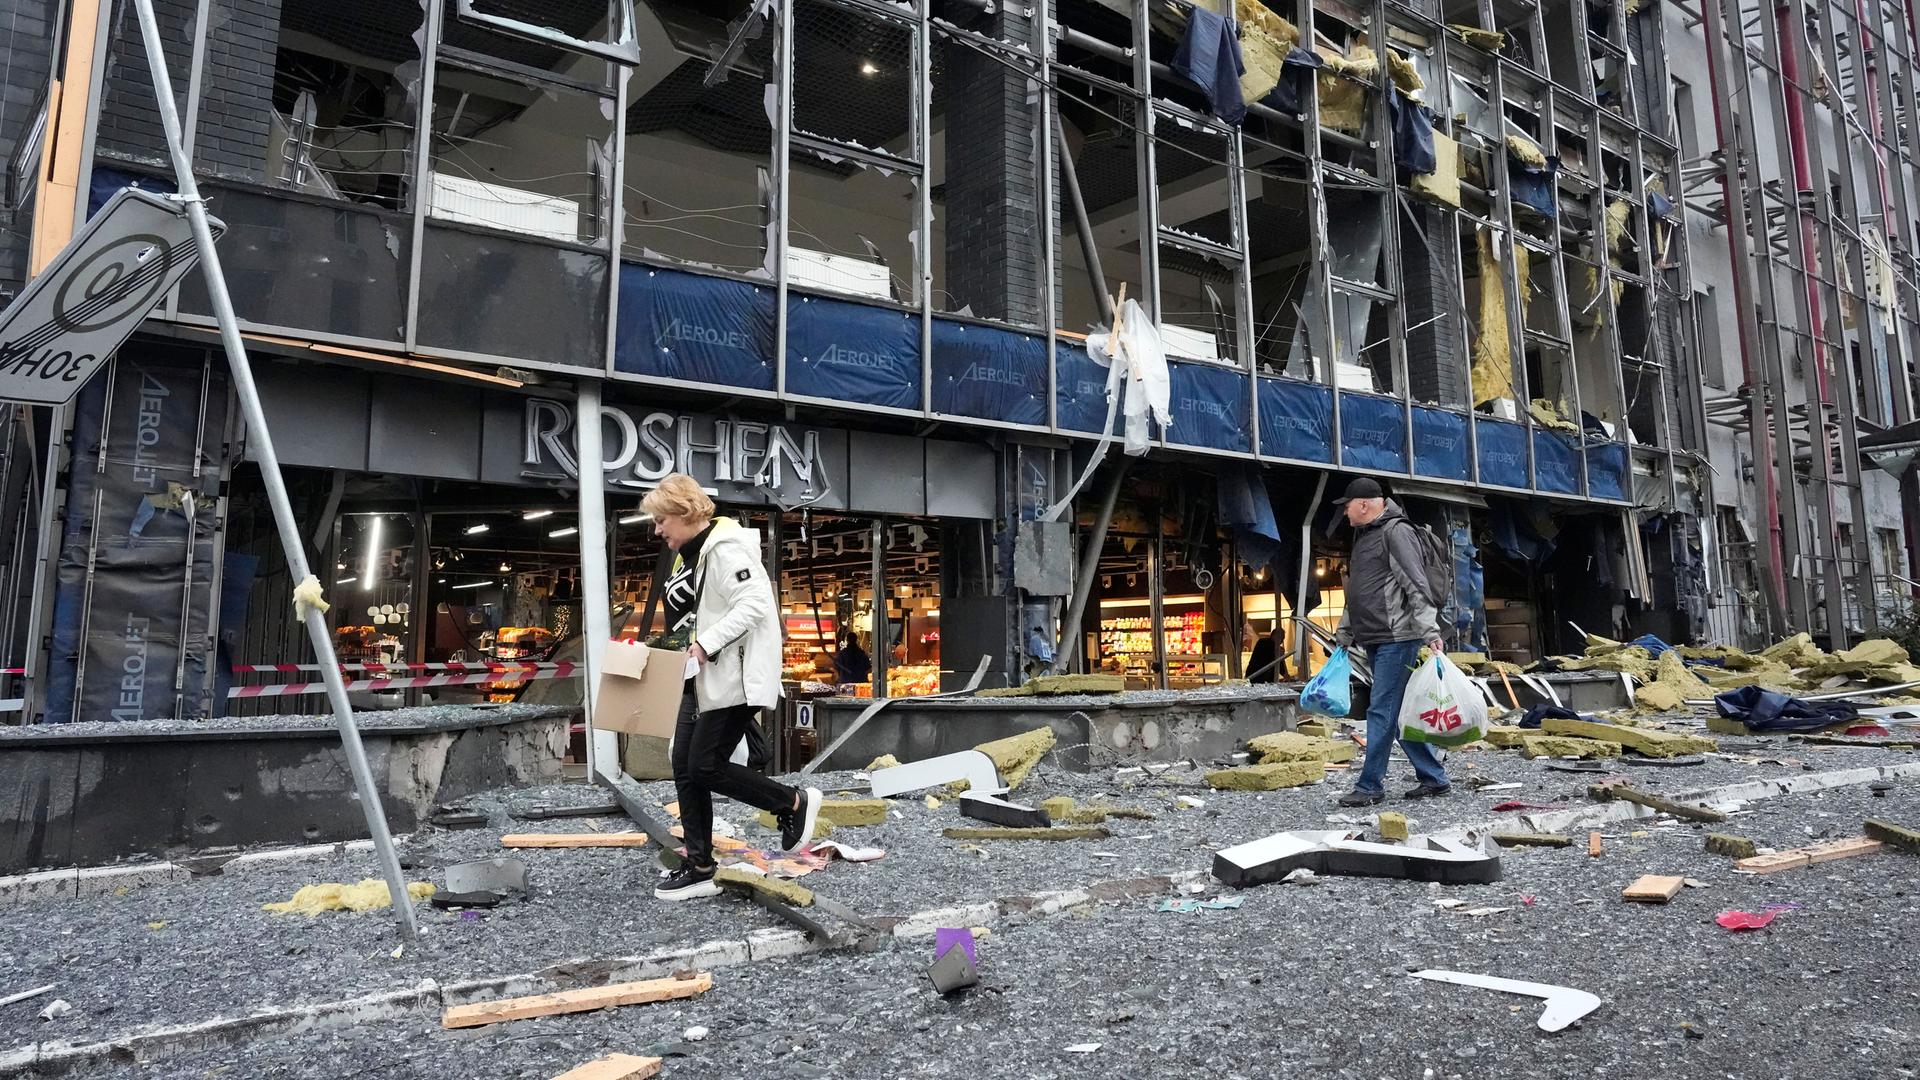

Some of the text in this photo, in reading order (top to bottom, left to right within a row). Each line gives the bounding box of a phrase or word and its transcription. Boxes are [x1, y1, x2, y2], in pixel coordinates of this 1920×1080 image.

[656, 318, 750, 348] AEROJET
[813, 344, 896, 370] AEROJET
[957, 362, 1026, 387] AEROJET
[1075, 379, 1106, 397] OJET
[132, 362, 170, 488] AEROJET
[524, 398, 822, 490] ROSHEN
